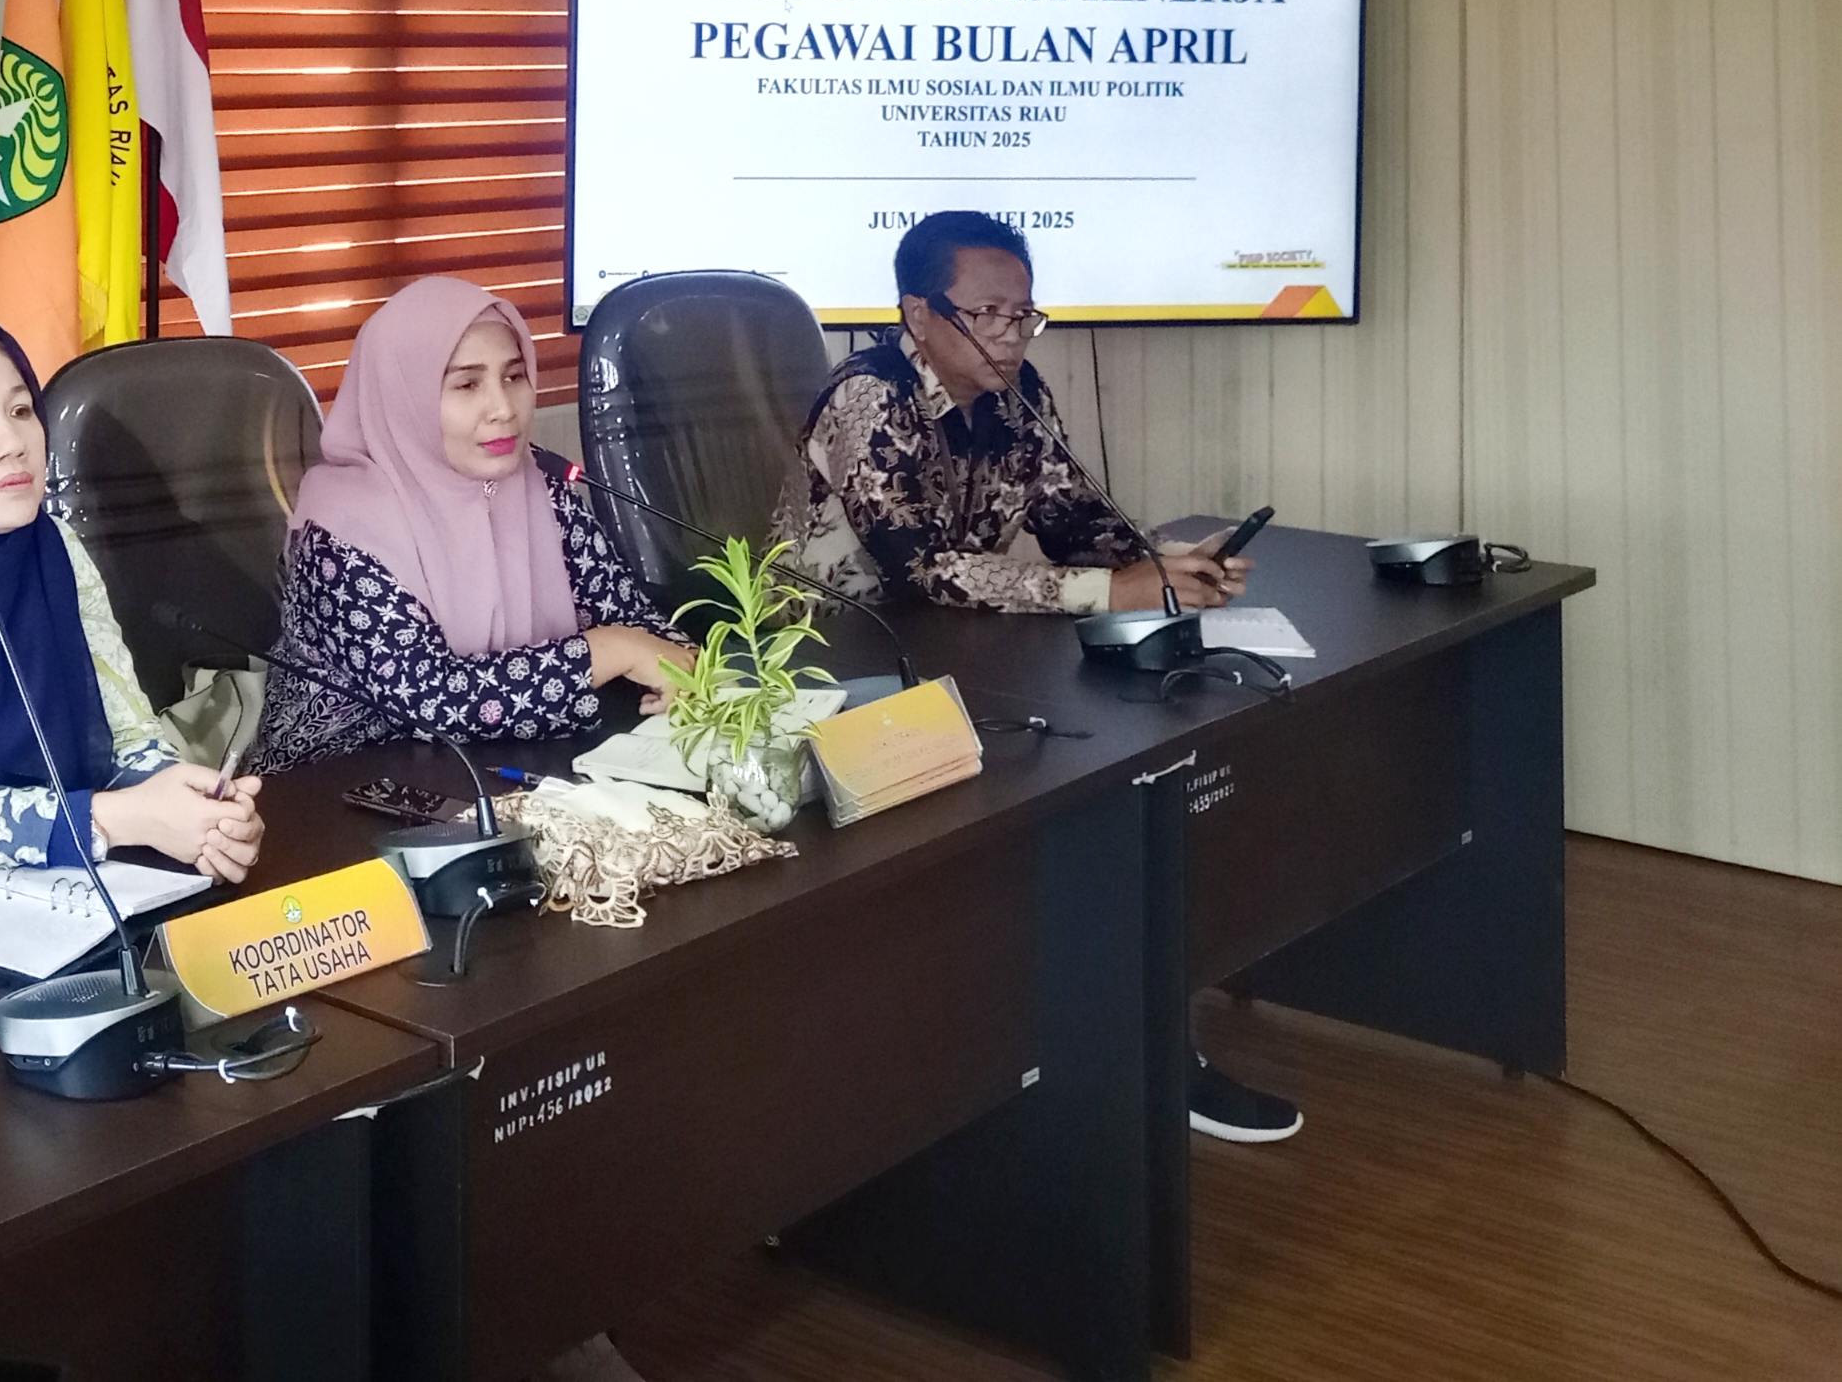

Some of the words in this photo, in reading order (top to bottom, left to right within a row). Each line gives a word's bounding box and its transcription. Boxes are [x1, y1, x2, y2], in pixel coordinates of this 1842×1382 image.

[689, 22, 918, 61] PEGAWAI
[931, 25, 1097, 63] BULAN
[1106, 27, 1248, 65] APRIL
[757, 78, 862, 95] FAKULTAS
[867, 79, 920, 95] ILMU
[925, 79, 998, 96] SOSIAL
[1001, 80, 1044, 97] DAN
[1049, 81, 1100, 97] ILMU
[1106, 81, 1185, 98] POLITIK
[881, 105, 1012, 122] UNIVERSITAS
[1019, 106, 1067, 122] RIAU
[917, 131, 987, 148] TAHUN
[992, 131, 1031, 148] 2025
[1031, 211, 1074, 229] 2025
[228, 909, 372, 975] KOORDINATOR
[247, 962, 304, 999] TATA
[302, 940, 372, 981] USAHA
